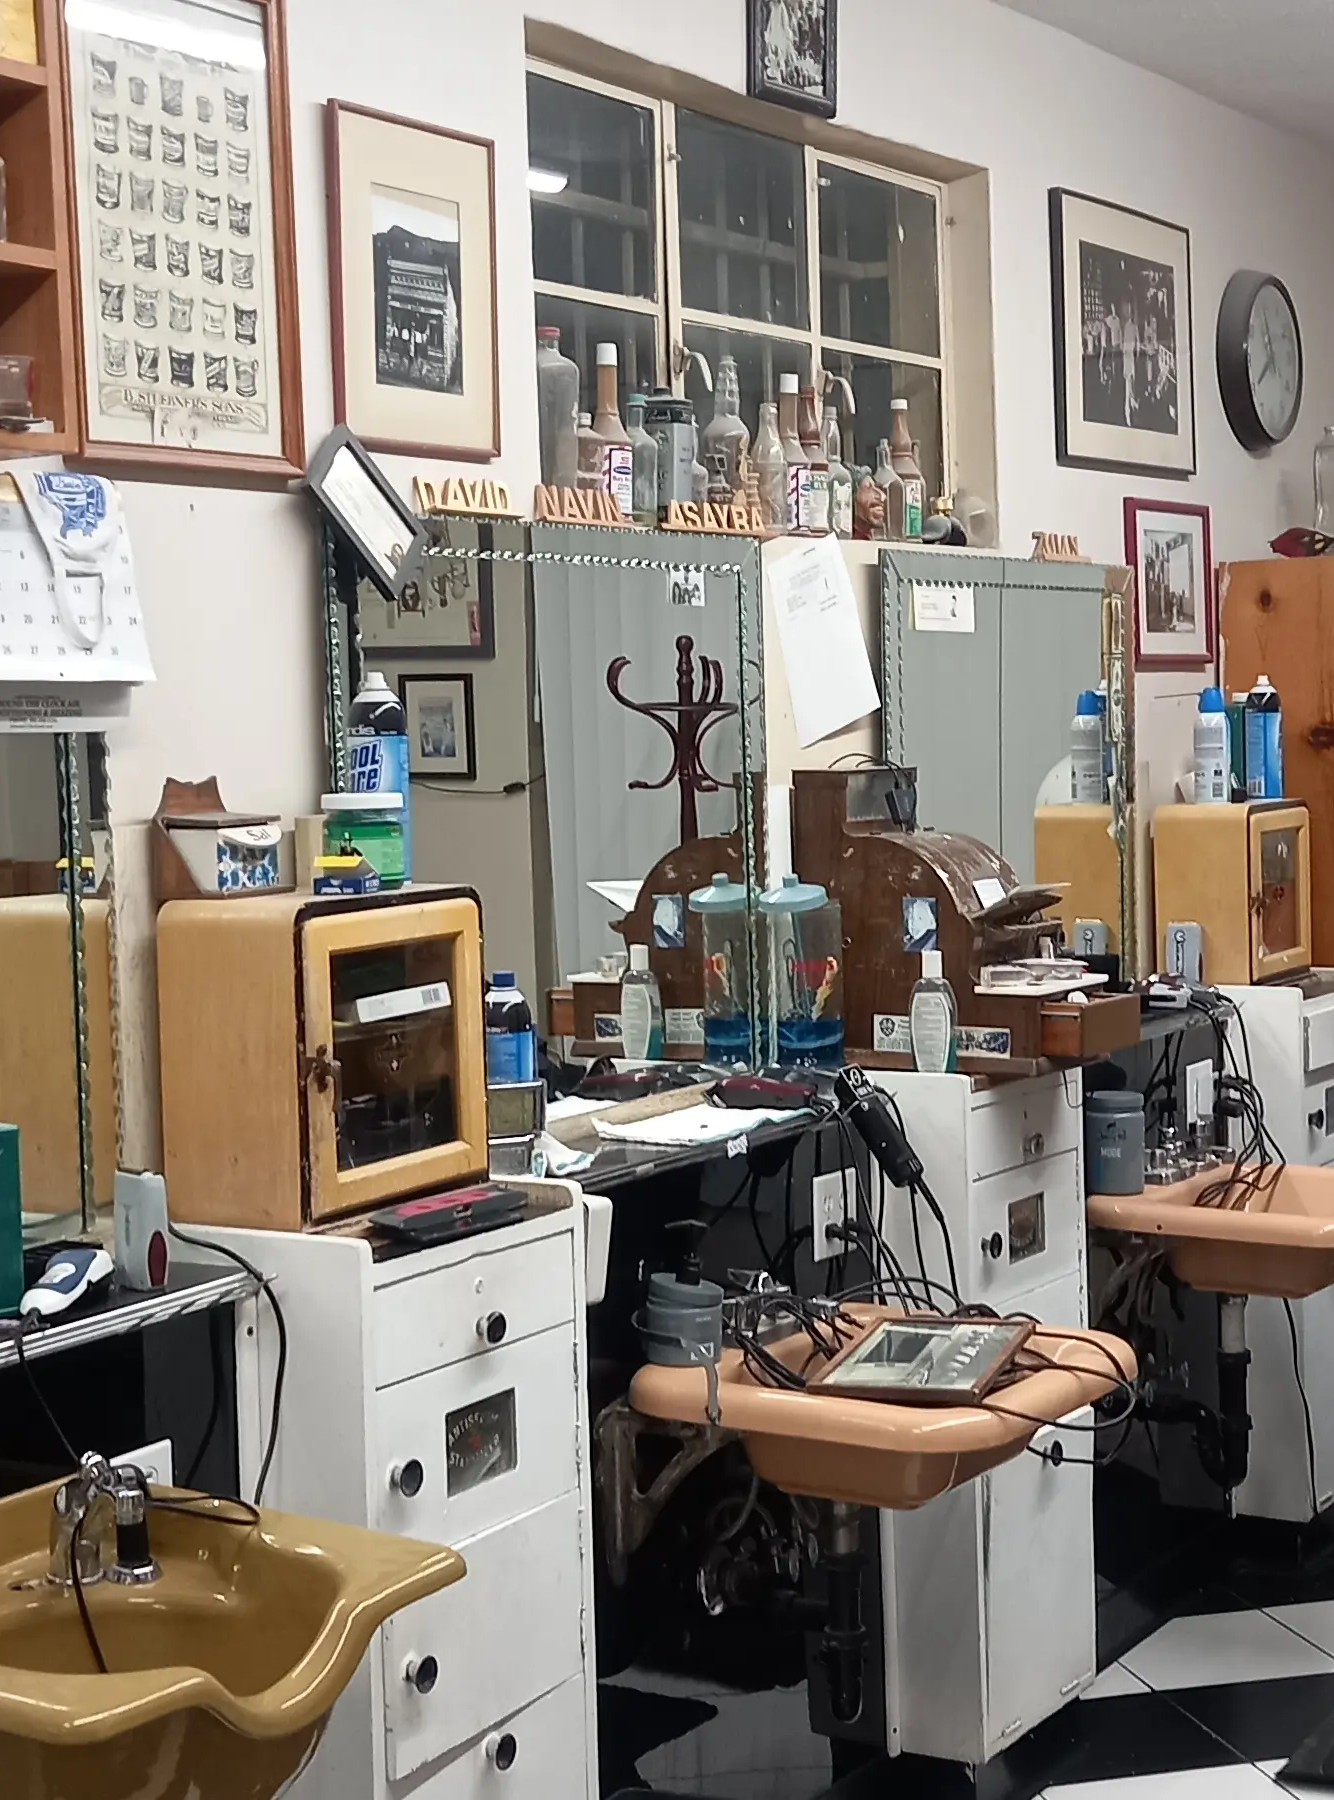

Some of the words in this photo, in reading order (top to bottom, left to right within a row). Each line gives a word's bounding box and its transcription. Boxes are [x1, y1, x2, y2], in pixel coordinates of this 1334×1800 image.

[415, 476, 509, 513] DAVID
[534, 484, 622, 523] NAVIN
[20, 582, 29, 592] 13
[347, 724, 375, 735] ndis
[351, 743, 379, 770] OOL
